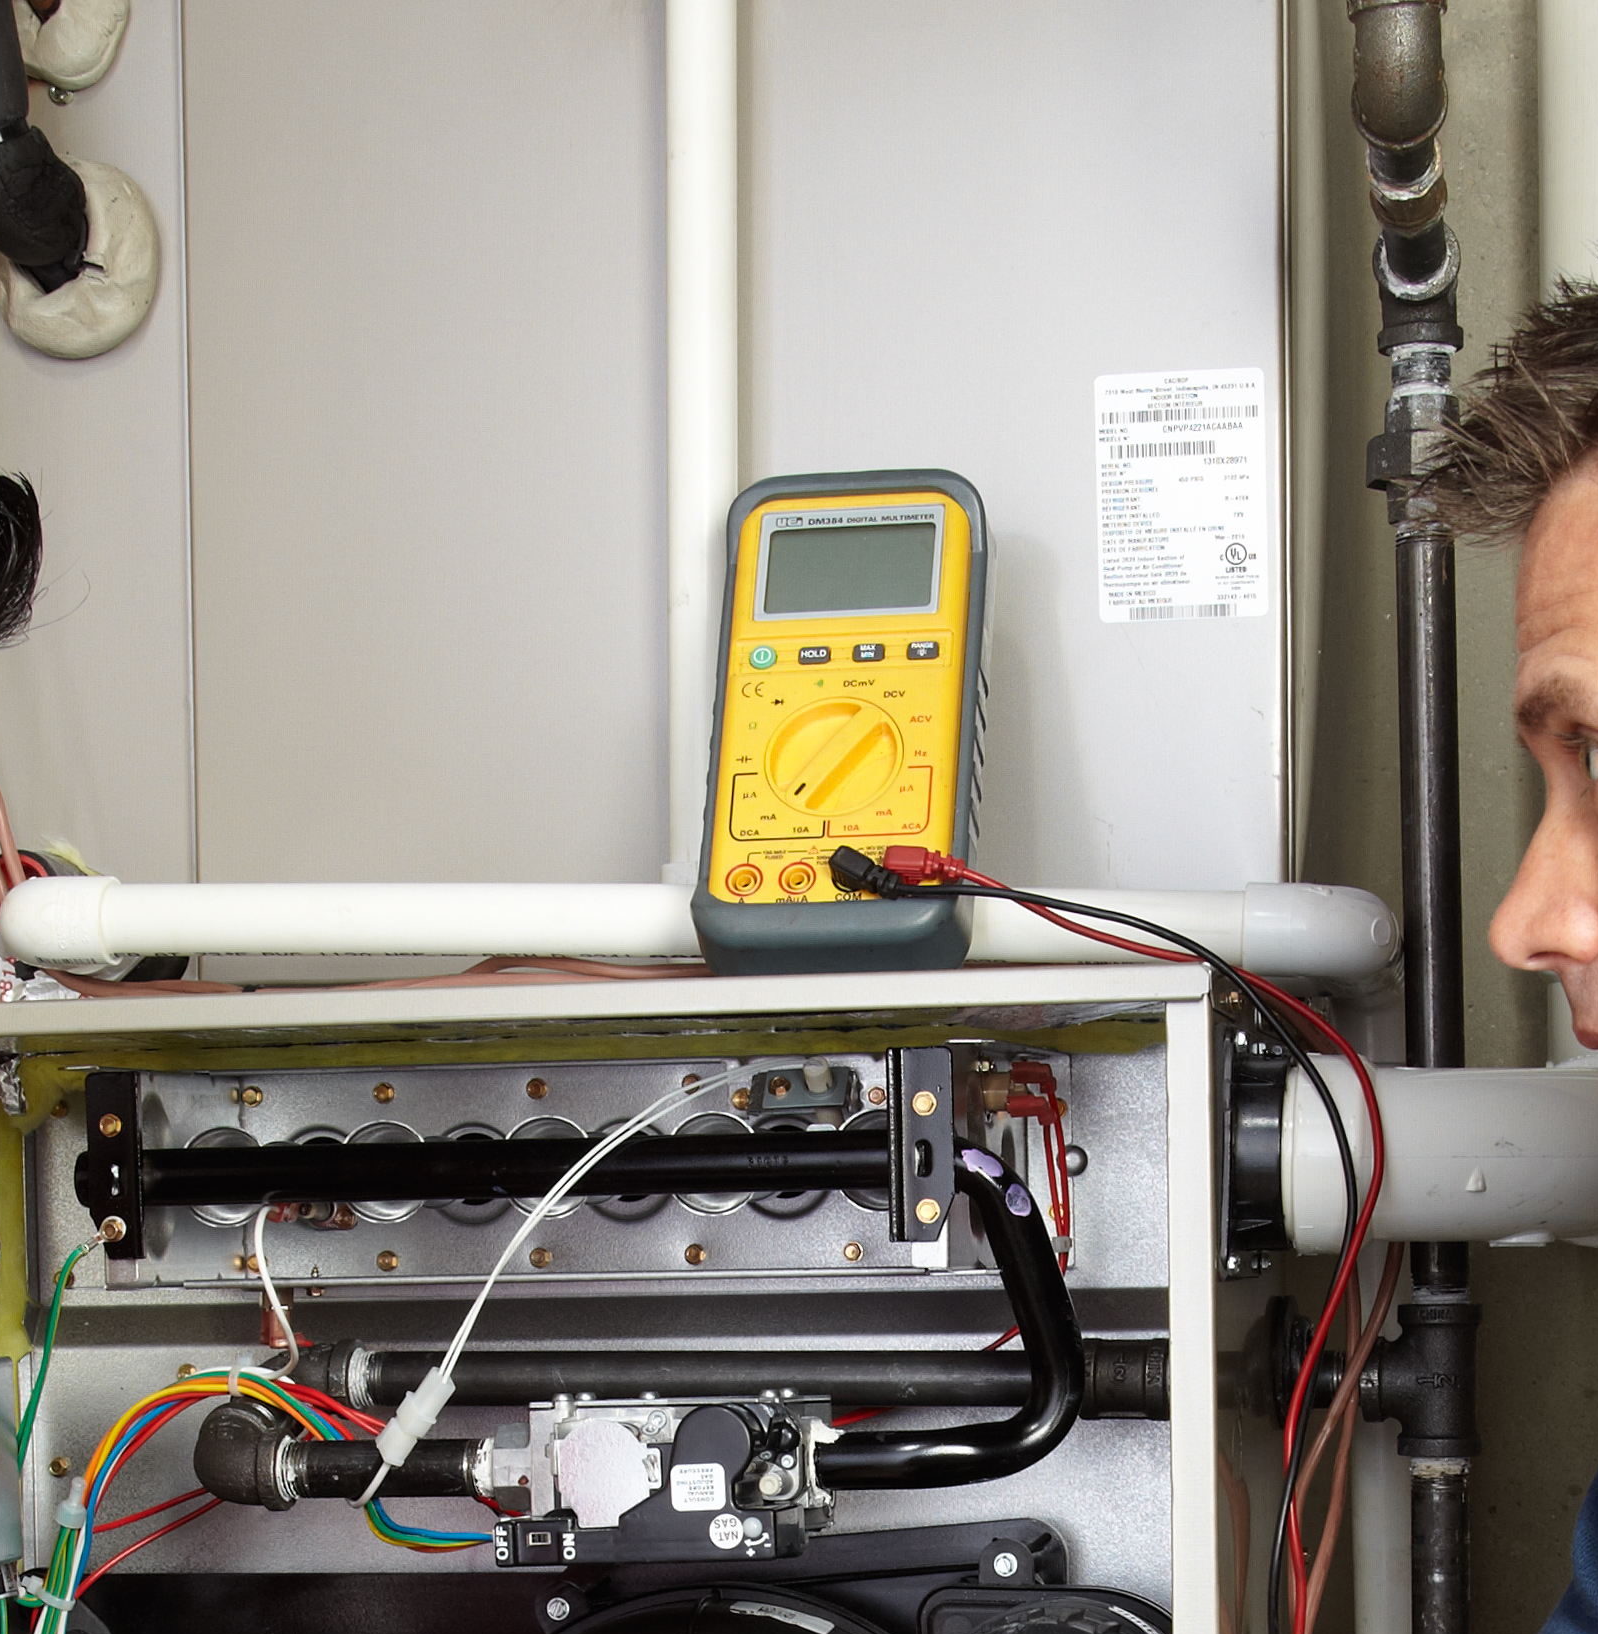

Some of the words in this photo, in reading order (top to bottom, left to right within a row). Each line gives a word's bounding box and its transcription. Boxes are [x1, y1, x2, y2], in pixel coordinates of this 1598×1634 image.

[847, 515, 878, 524] DIGITAL
[881, 513, 935, 522] MULTIMETER
[800, 649, 827, 659] HOLD
[843, 679, 875, 688] DCmV
[883, 690, 906, 699] DCV
[910, 715, 932, 723] ACV
[760, 813, 777, 821] mA
[876, 808, 893, 817] mA
[792, 826, 809, 834] 10A
[843, 824, 860, 832] 10A
[902, 822, 921, 830] ACA
[739, 829, 760, 837] DCA
[835, 892, 862, 902] COM
[713, 1518, 737, 1528] GAS
[714, 1529, 739, 1542] NAT.
[496, 1525, 509, 1560] OFF
[562, 1532, 576, 1560] ON
